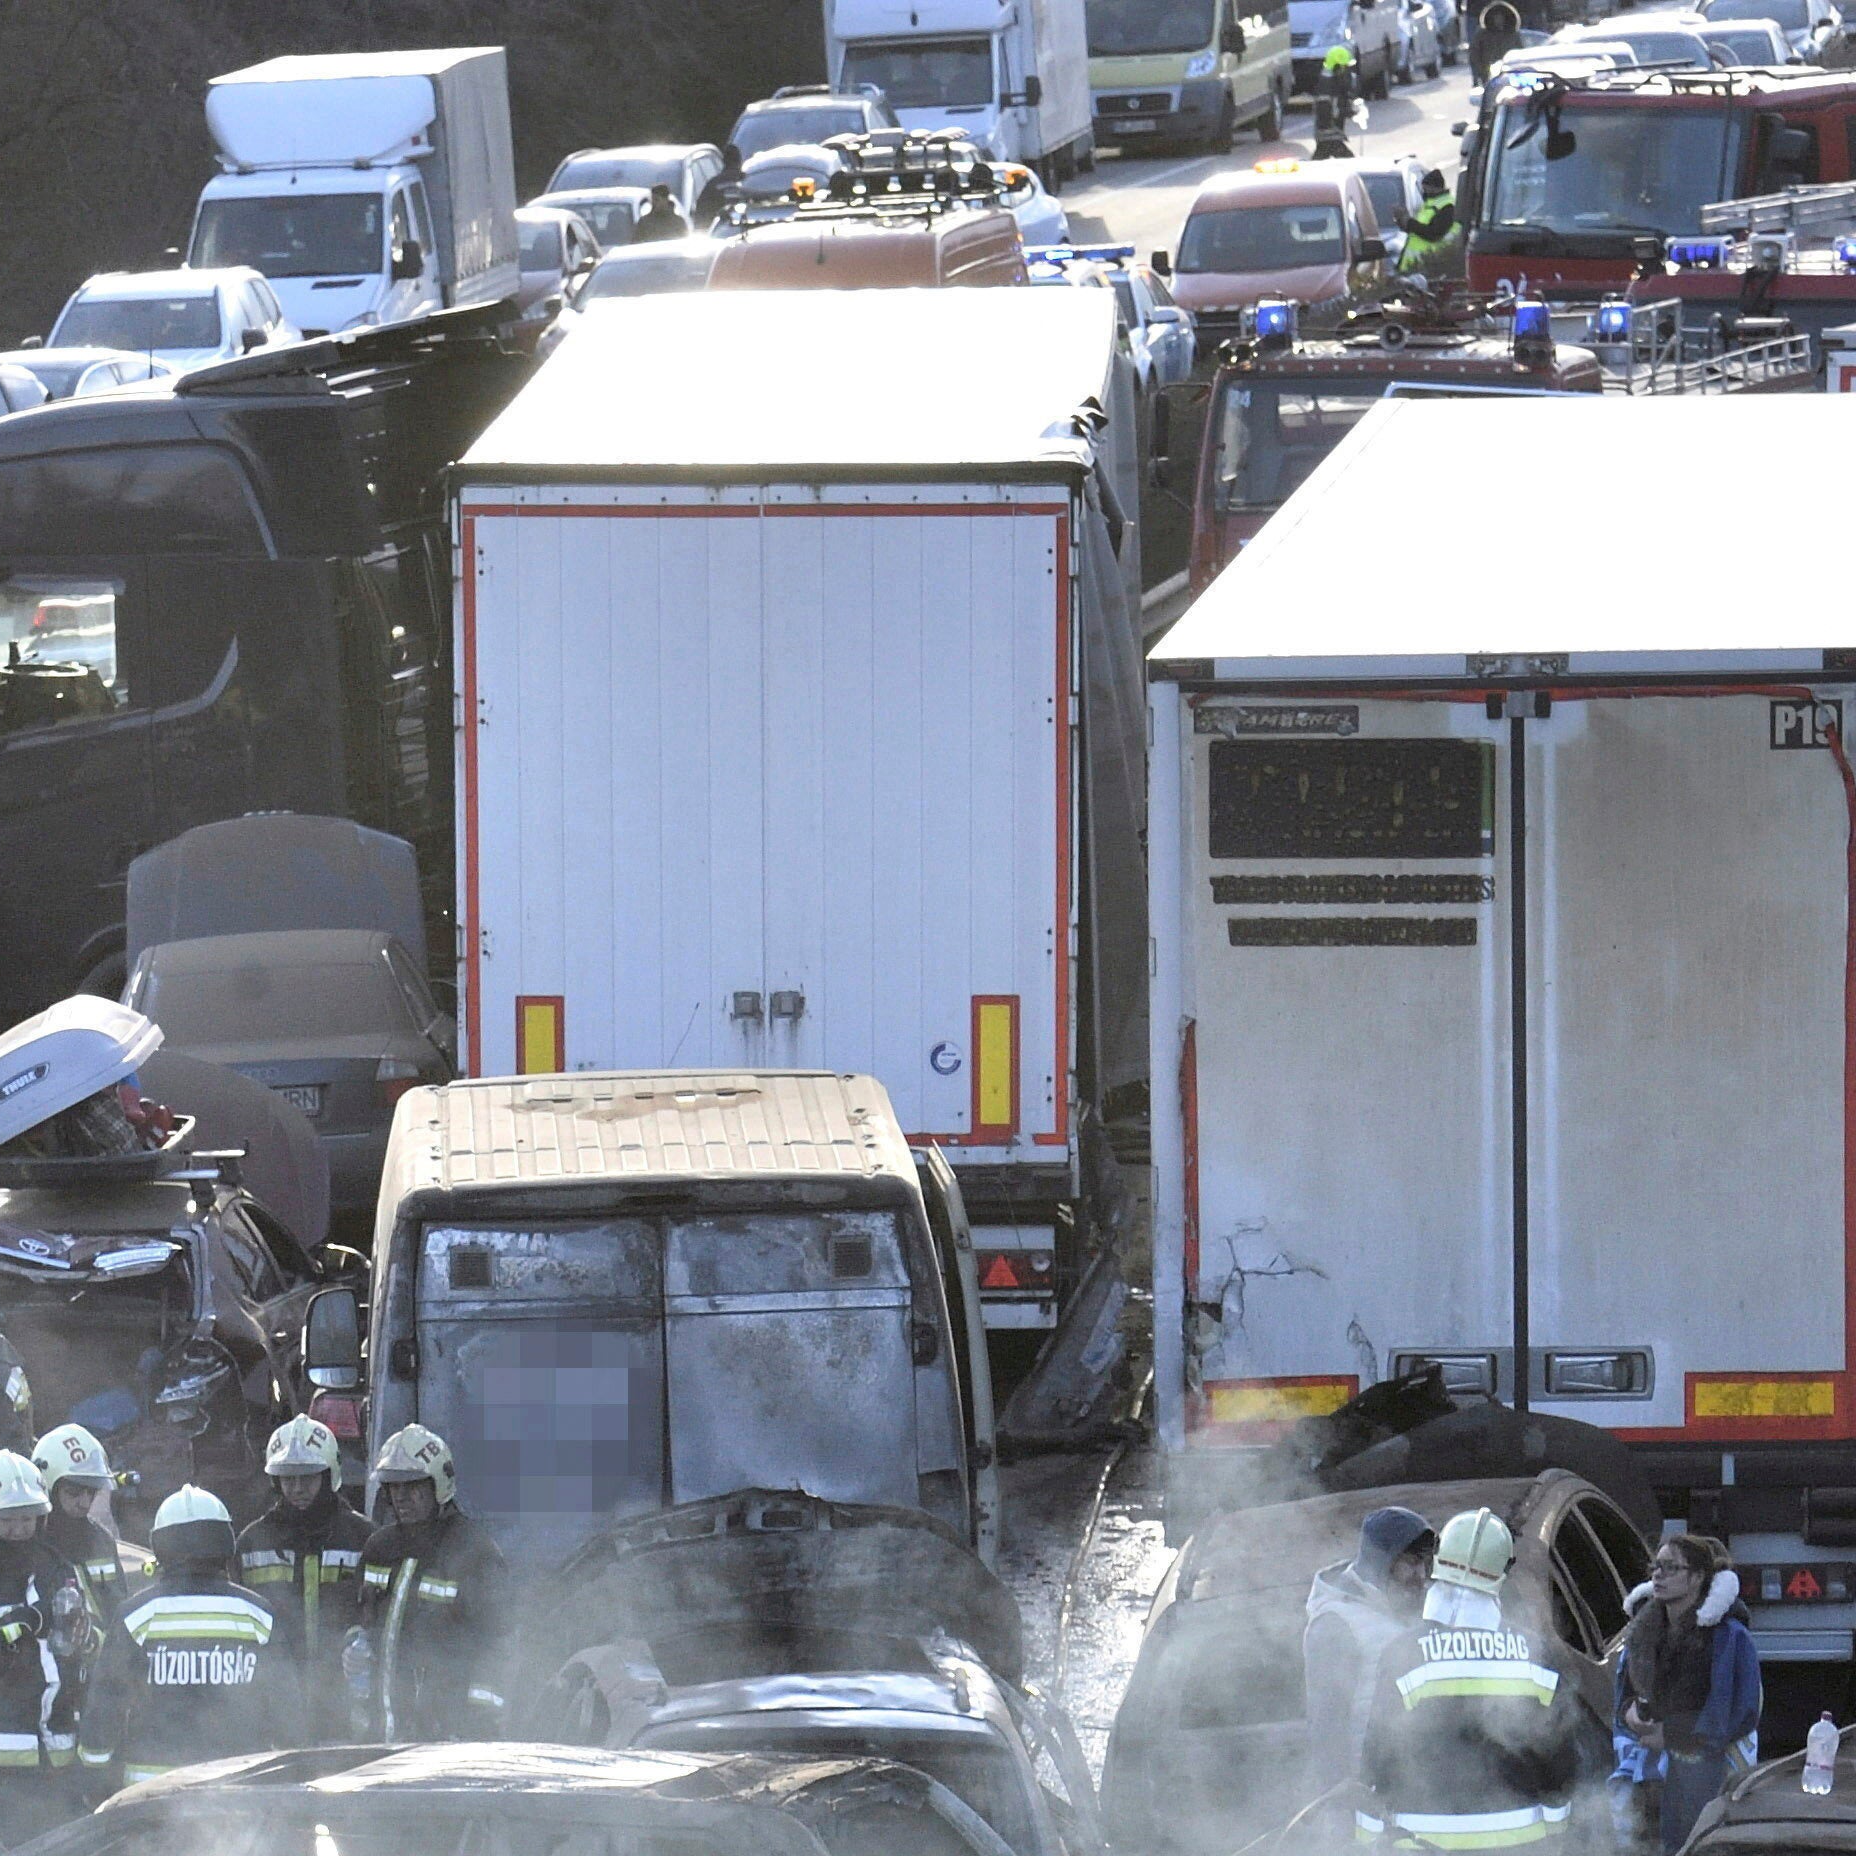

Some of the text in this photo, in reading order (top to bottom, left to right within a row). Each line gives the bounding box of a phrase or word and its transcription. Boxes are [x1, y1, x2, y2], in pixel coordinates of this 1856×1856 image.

[62, 1436, 86, 1464] EG
[305, 1427, 327, 1449] TB
[414, 1440, 441, 1464] TB
[146, 1644, 257, 1685] TŰZOLTÓSÁG
